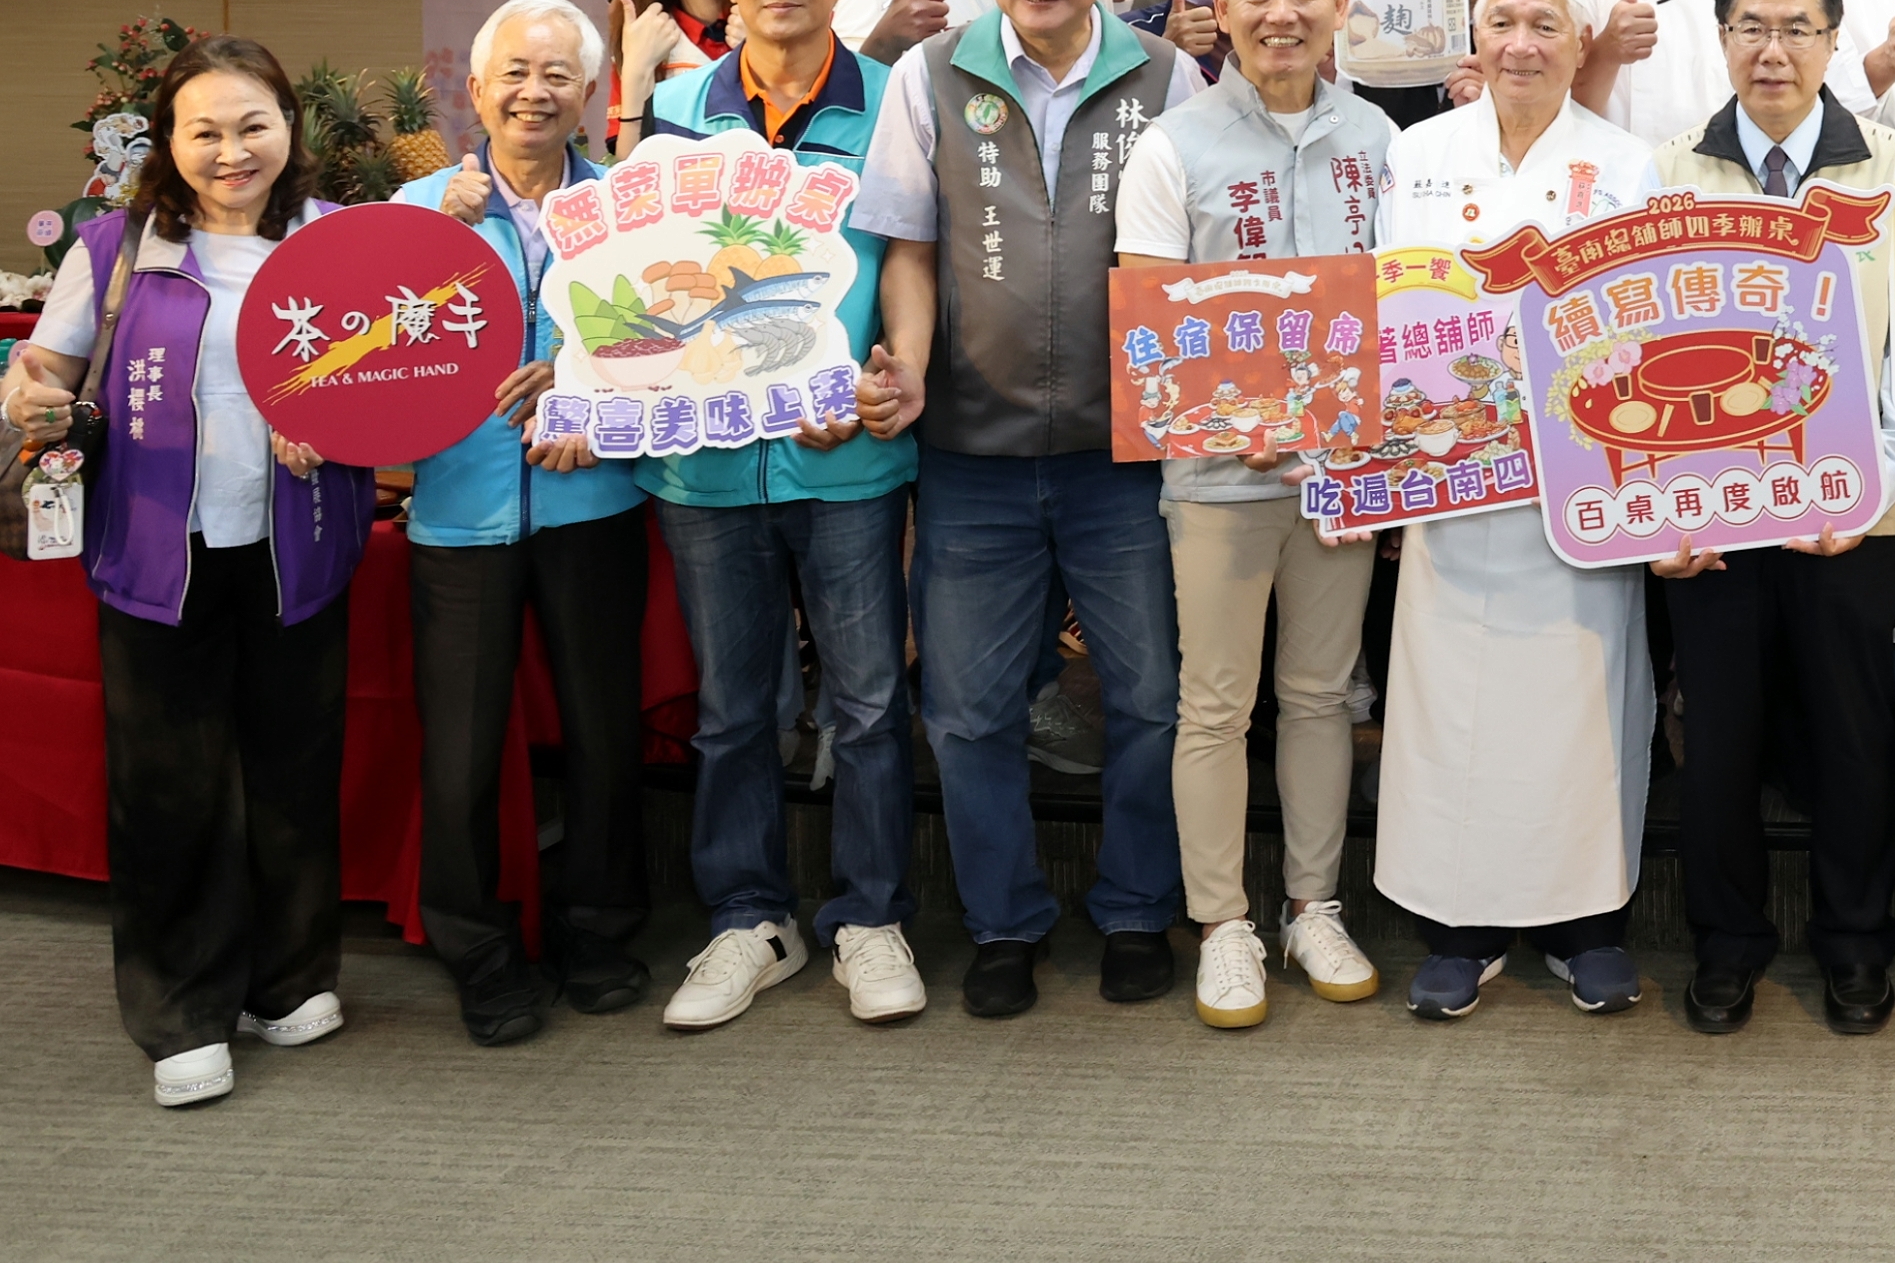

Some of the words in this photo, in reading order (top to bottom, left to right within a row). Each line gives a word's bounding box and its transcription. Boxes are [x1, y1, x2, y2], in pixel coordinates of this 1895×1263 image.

[978, 141, 1002, 188] 特助
[1089, 132, 1113, 214] 服務團隊
[1358, 150, 1376, 199] 立法委員
[547, 152, 853, 260] 無菜單辦桌
[1260, 170, 1283, 222] 市議員
[1330, 156, 1365, 254] 陳亭
[1648, 193, 1694, 215] 2026
[982, 205, 1005, 281] 王世運
[1376, 257, 1452, 283] 季一饗
[1551, 214, 1799, 279] 臺南總舖師四季辦桌
[271, 281, 488, 362] 茶の魔手
[1123, 309, 1364, 367] 住宿保留席
[147, 347, 166, 401] 理事長
[311, 375, 338, 388] TEA
[342, 373, 353, 384] &
[358, 368, 409, 383] MAGIC
[414, 363, 459, 377] HAND
[542, 365, 857, 451] 驚喜美味上菜
[1306, 451, 1533, 516] 吃遍台南四
[1575, 470, 1852, 531] 百桌再度啟航
